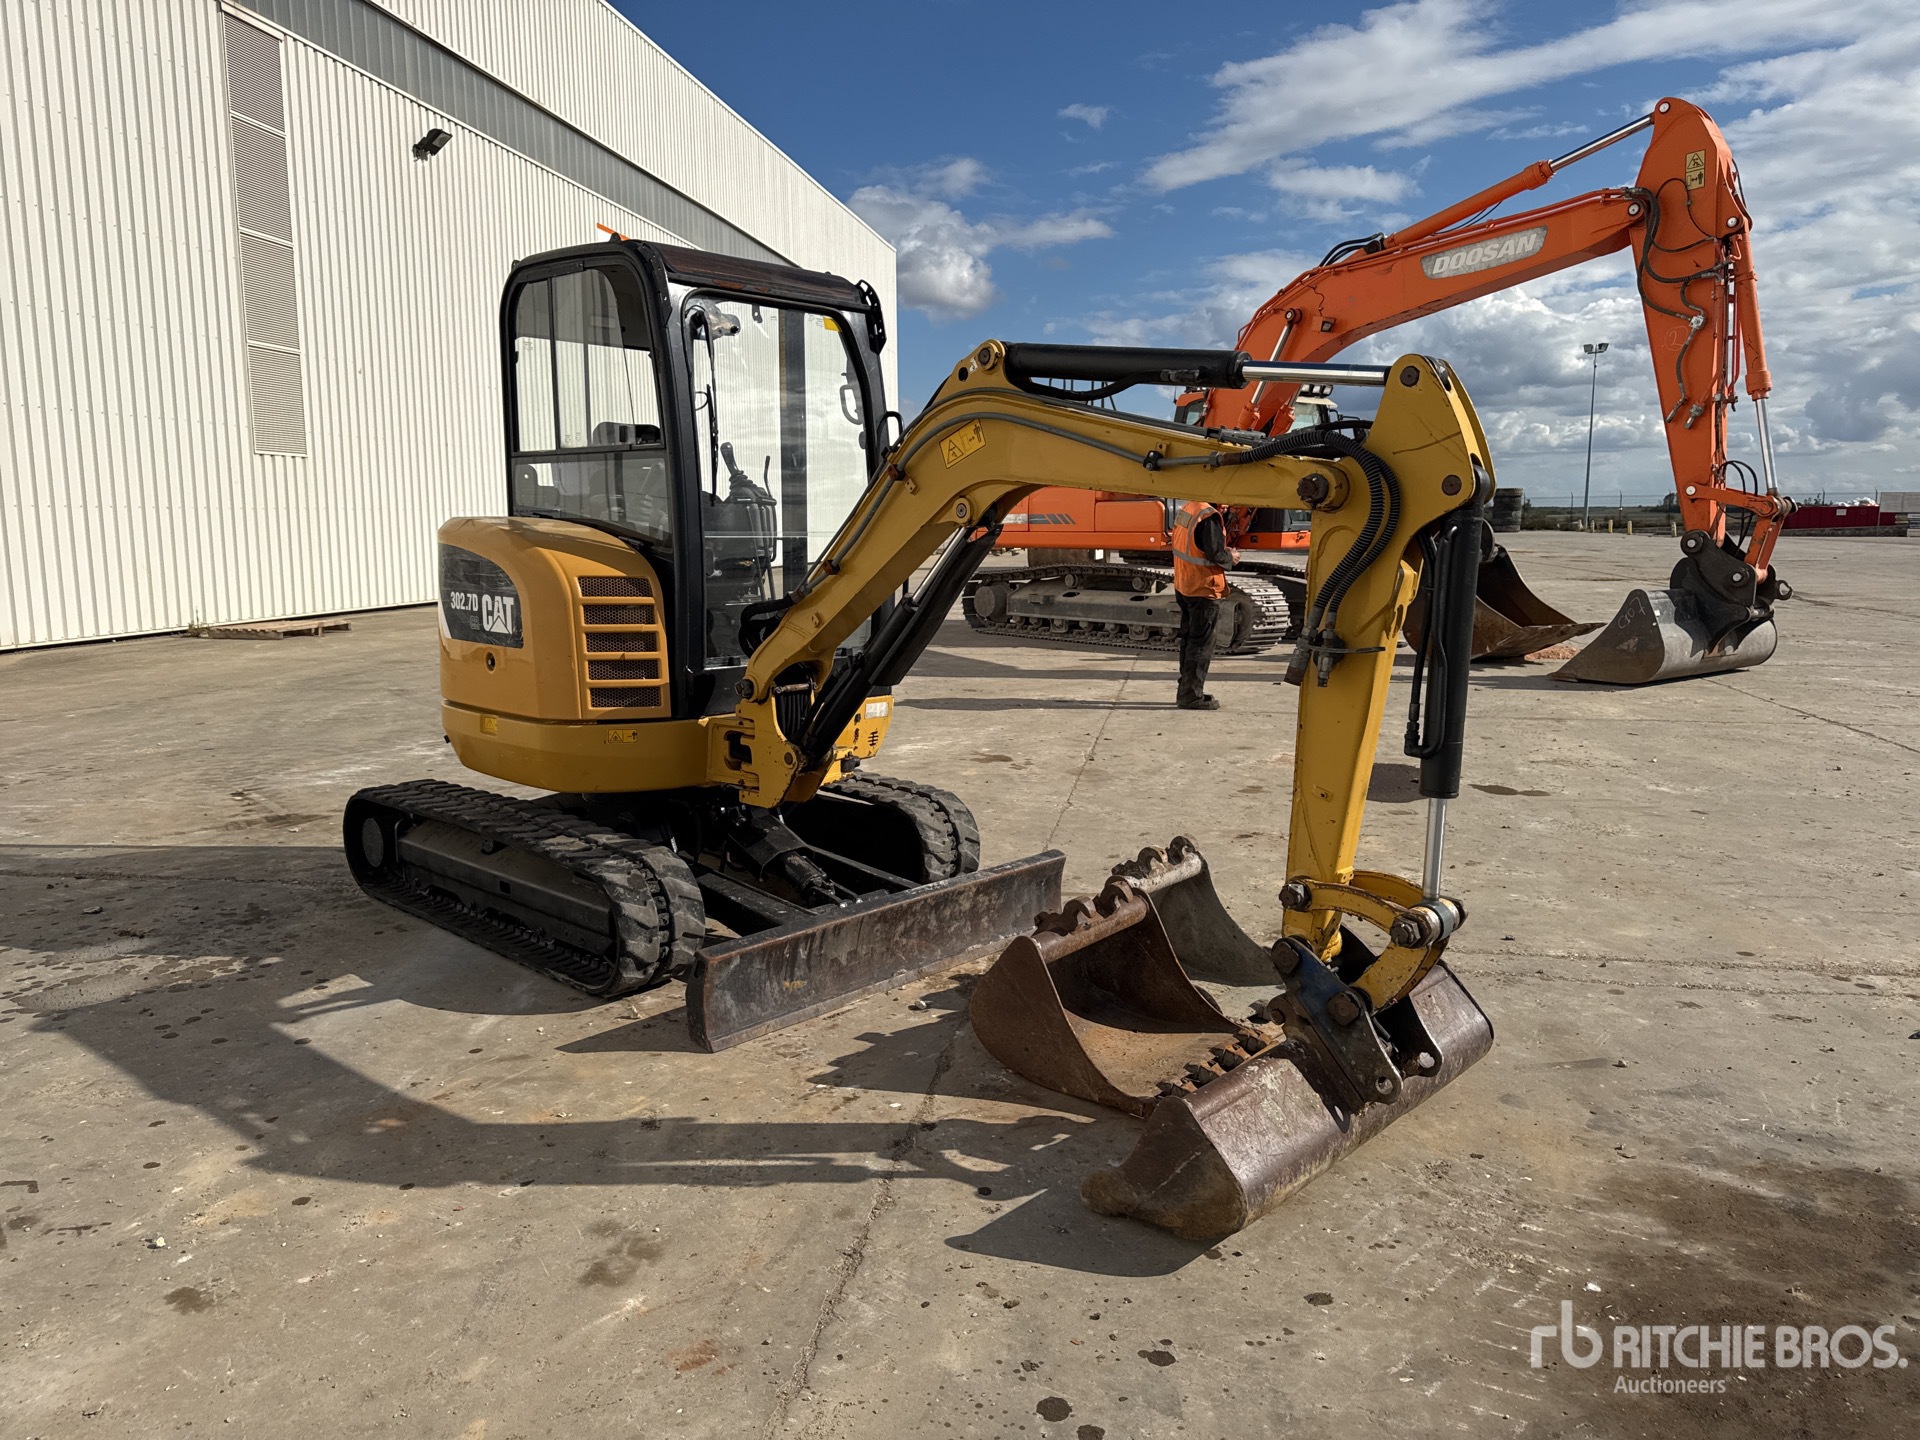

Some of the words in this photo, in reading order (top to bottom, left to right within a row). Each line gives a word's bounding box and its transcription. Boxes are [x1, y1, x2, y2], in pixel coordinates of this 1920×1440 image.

[1432, 234, 1537, 274] DOOSAN
[450, 591, 479, 612] 302.7D
[482, 594, 515, 635] CAT
